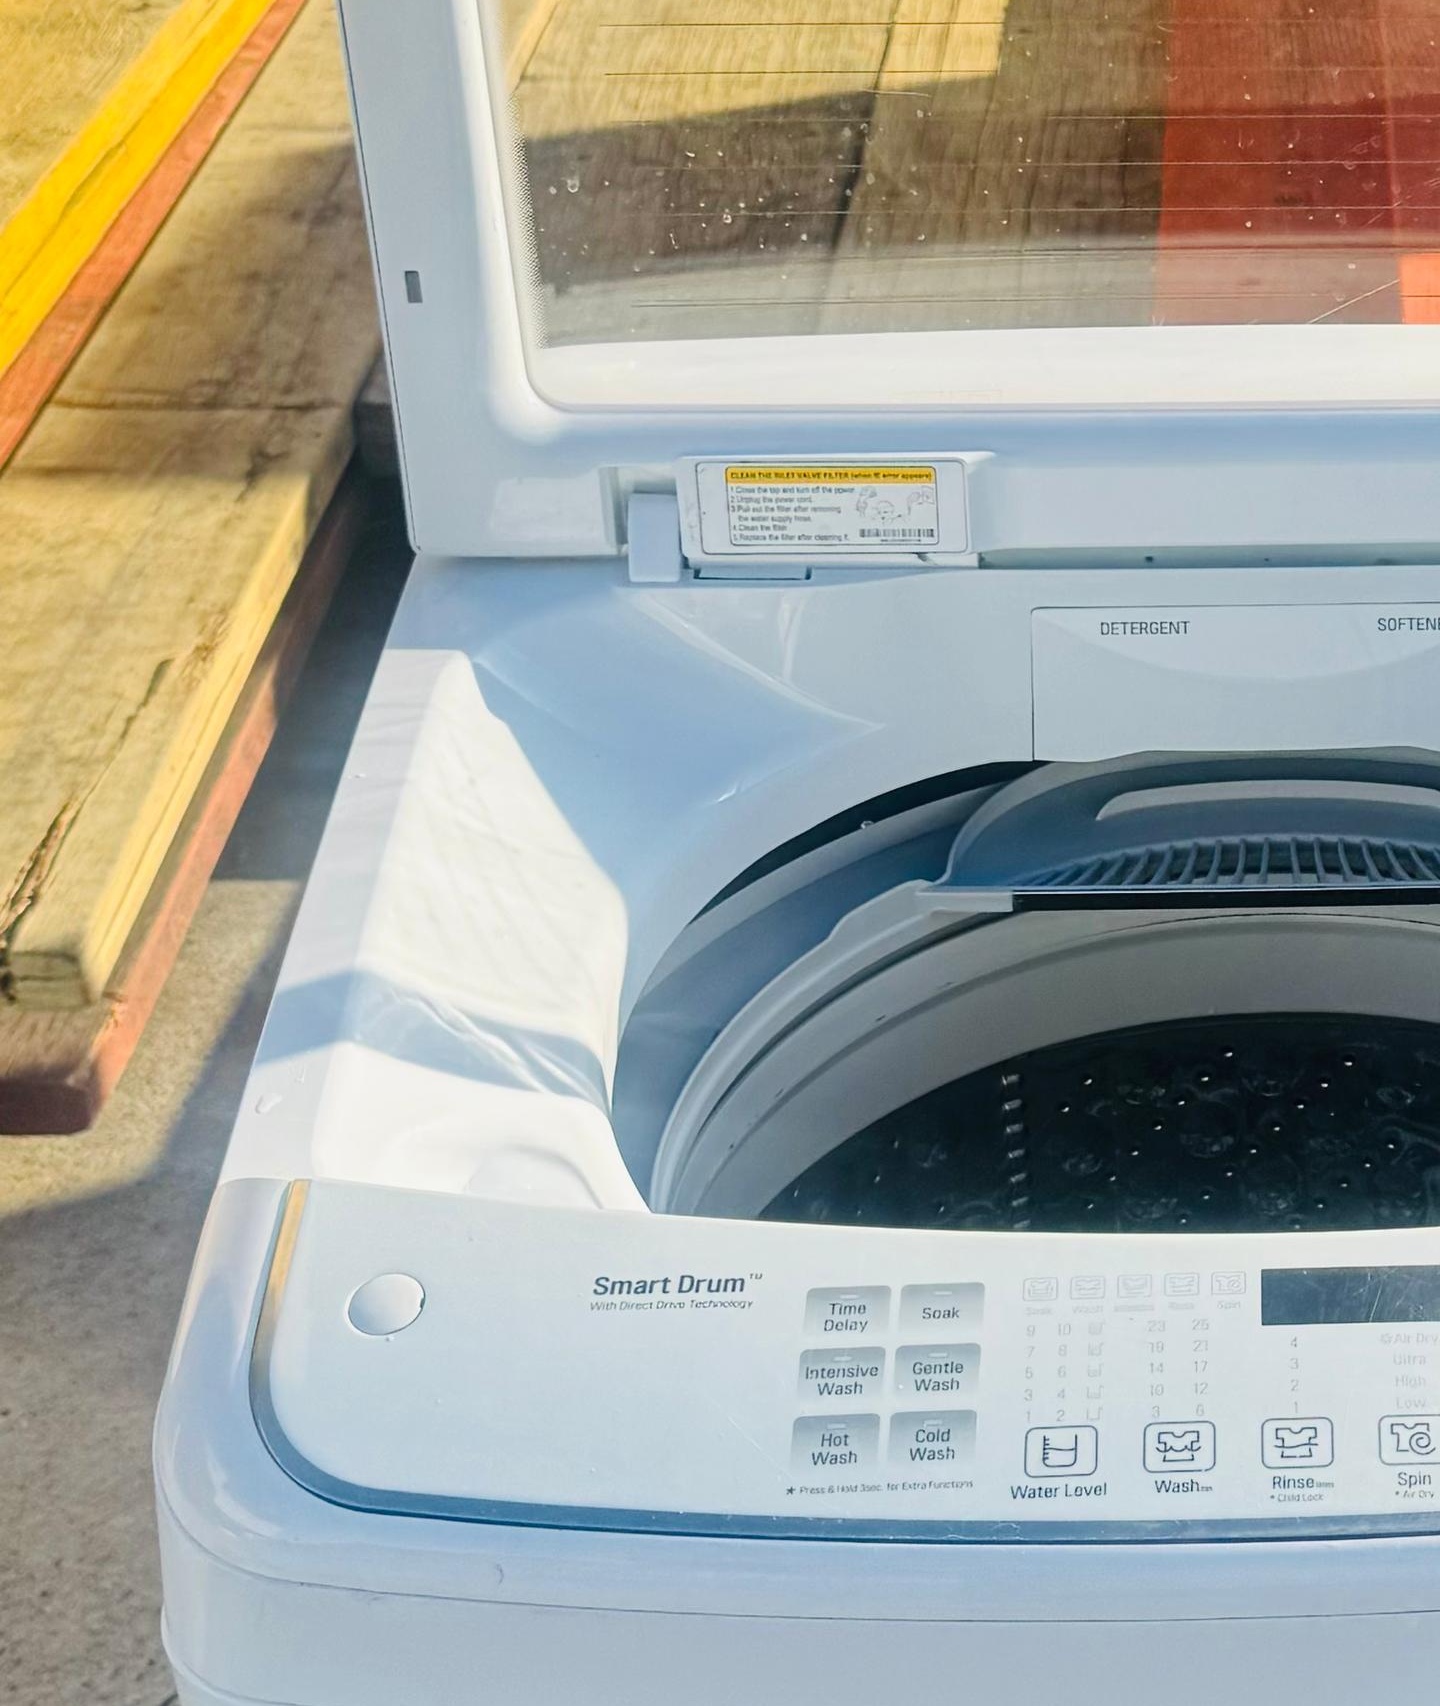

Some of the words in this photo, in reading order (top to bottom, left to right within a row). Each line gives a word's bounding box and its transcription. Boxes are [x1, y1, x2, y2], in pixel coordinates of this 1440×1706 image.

[1099, 619, 1191, 637] DETERGENT
[592, 1275, 672, 1296] Smart
[677, 1274, 746, 1294] Drum
[589, 1301, 617, 1312] With
[618, 1300, 654, 1311] Direct
[655, 1299, 686, 1310] Drive
[689, 1298, 755, 1310] Technology
[828, 1301, 868, 1316] Time
[921, 1306, 961, 1321] Soak
[823, 1318, 869, 1334] Delay
[1025, 1324, 1037, 1338] 9
[1057, 1322, 1072, 1337] 10
[1289, 1335, 1300, 1349] 4
[804, 1364, 880, 1380] Intensive
[911, 1360, 965, 1376] Gentle
[1149, 1361, 1165, 1374] 14
[1193, 1360, 1209, 1374] 17
[1288, 1357, 1300, 1371] 3
[816, 1380, 864, 1396] Wash
[913, 1376, 961, 1392] Wash
[1193, 1381, 1209, 1395] 12
[1289, 1378, 1301, 1392] 2
[1394, 1374, 1427, 1389] High
[1024, 1388, 1034, 1403] 3
[1056, 1387, 1067, 1401] 4
[1395, 1396, 1428, 1410] Low
[1056, 1409, 1066, 1423] 2
[820, 1431, 851, 1448] Hot
[914, 1428, 951, 1444] Cold
[810, 1450, 858, 1466] Wash
[909, 1445, 956, 1462] Wash
[1154, 1478, 1200, 1494] Wash
[1271, 1475, 1315, 1490] Rinse
[1396, 1470, 1433, 1489] Spin
[1009, 1483, 1060, 1500] Water
[1063, 1482, 1108, 1498] Level
